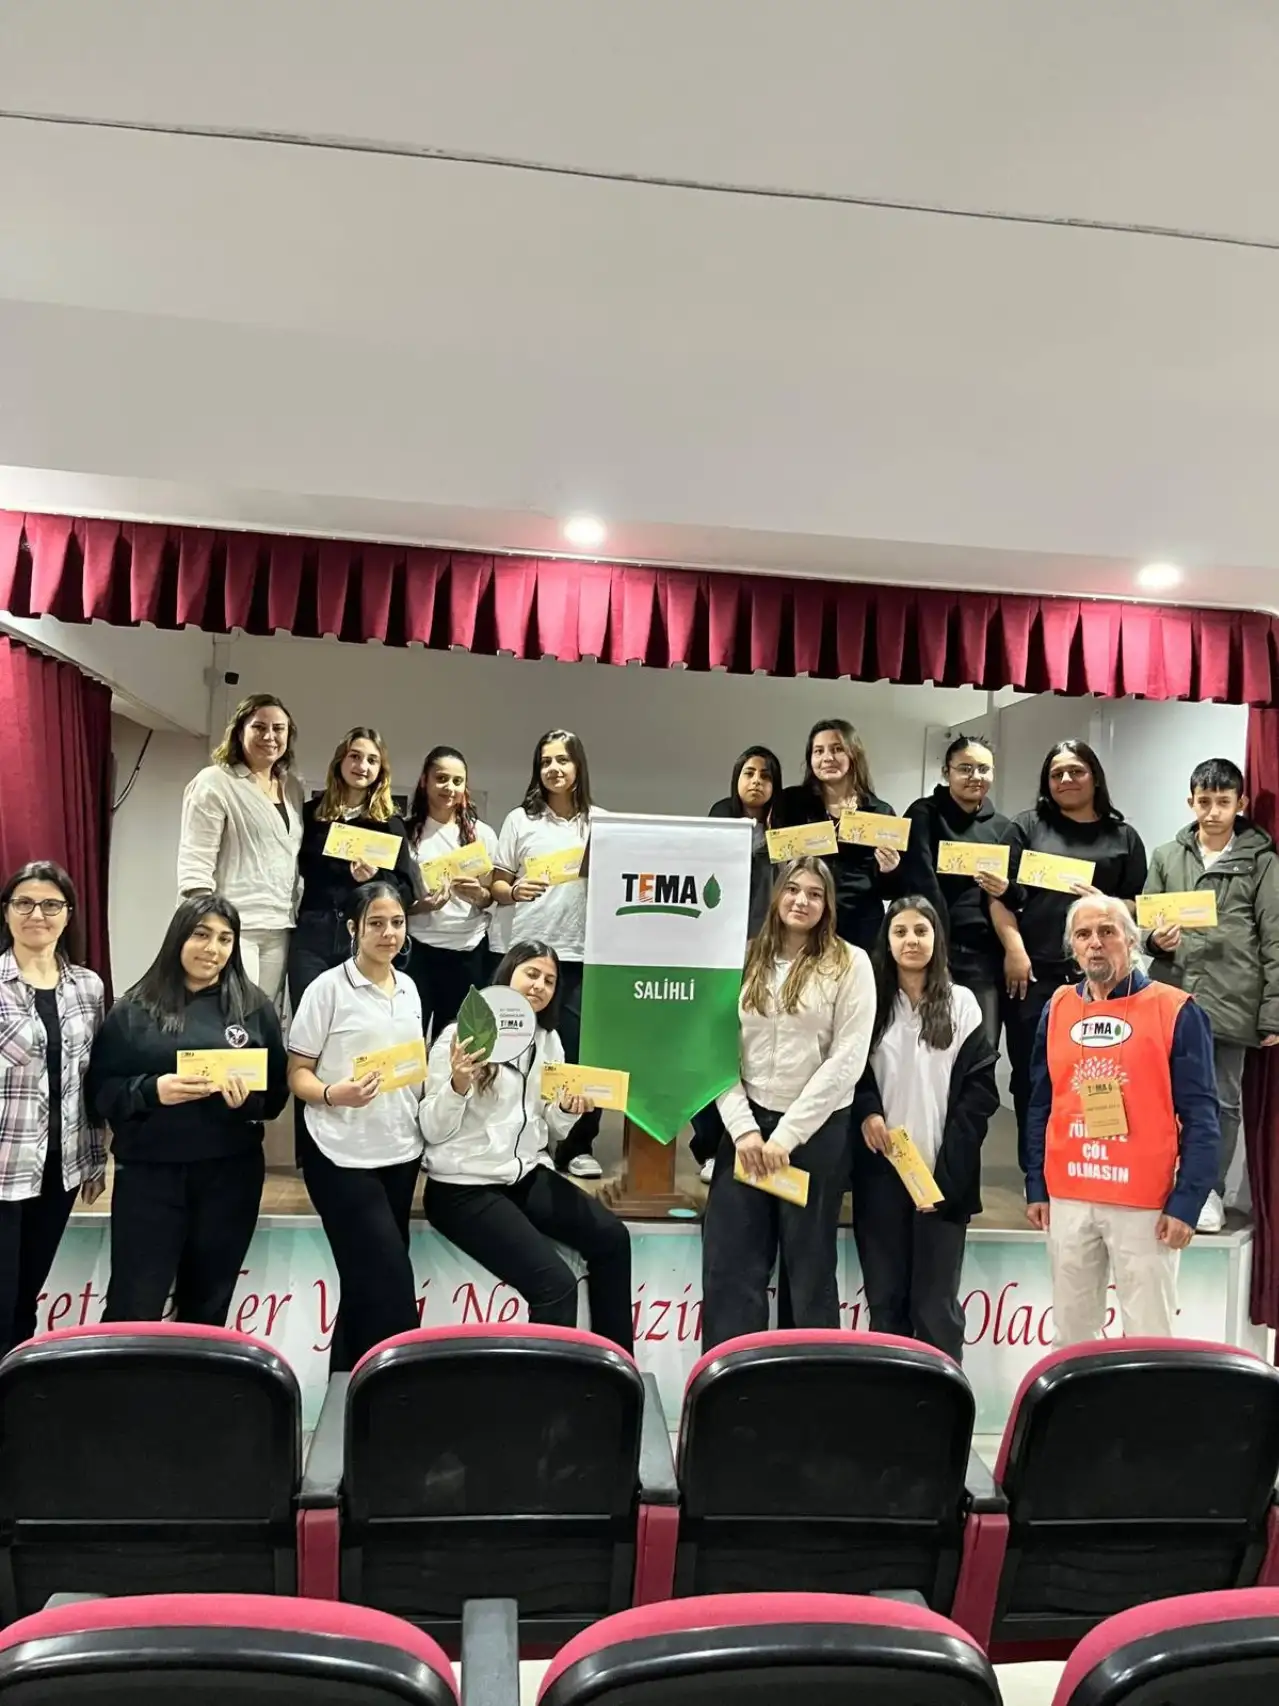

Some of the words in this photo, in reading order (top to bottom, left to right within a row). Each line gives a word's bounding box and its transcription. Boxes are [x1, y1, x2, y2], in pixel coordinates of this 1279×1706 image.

[622, 873, 698, 904] TEMA
[634, 978, 695, 1001] SALİHLİ
[1082, 1140, 1109, 1162] ÇÖL
[1067, 1161, 1129, 1184] OLMASIN
